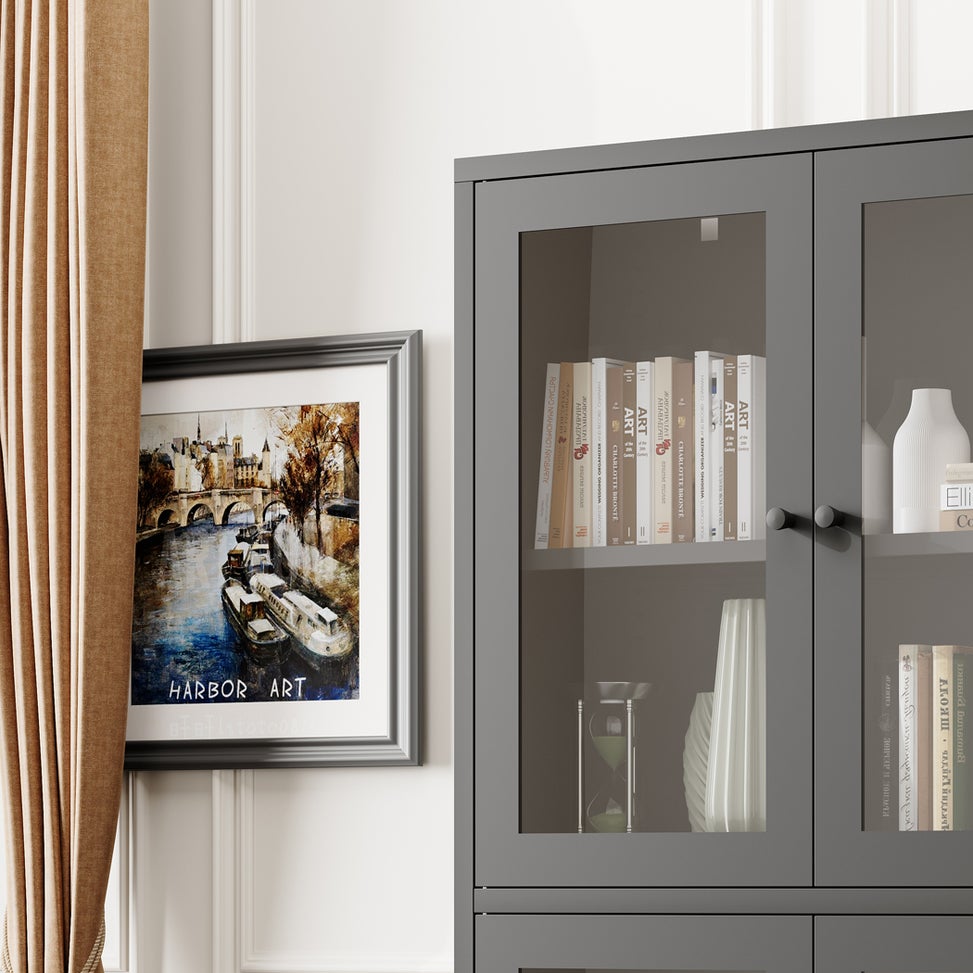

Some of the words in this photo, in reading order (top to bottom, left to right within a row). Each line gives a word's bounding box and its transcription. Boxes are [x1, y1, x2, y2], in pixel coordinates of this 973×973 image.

[624, 407, 634, 436] ART
[638, 406, 648, 435] ART
[725, 401, 735, 431] ART
[739, 400, 749, 430] ART
[168, 679, 248, 700] HARBOR
[270, 676, 307, 698] ART
